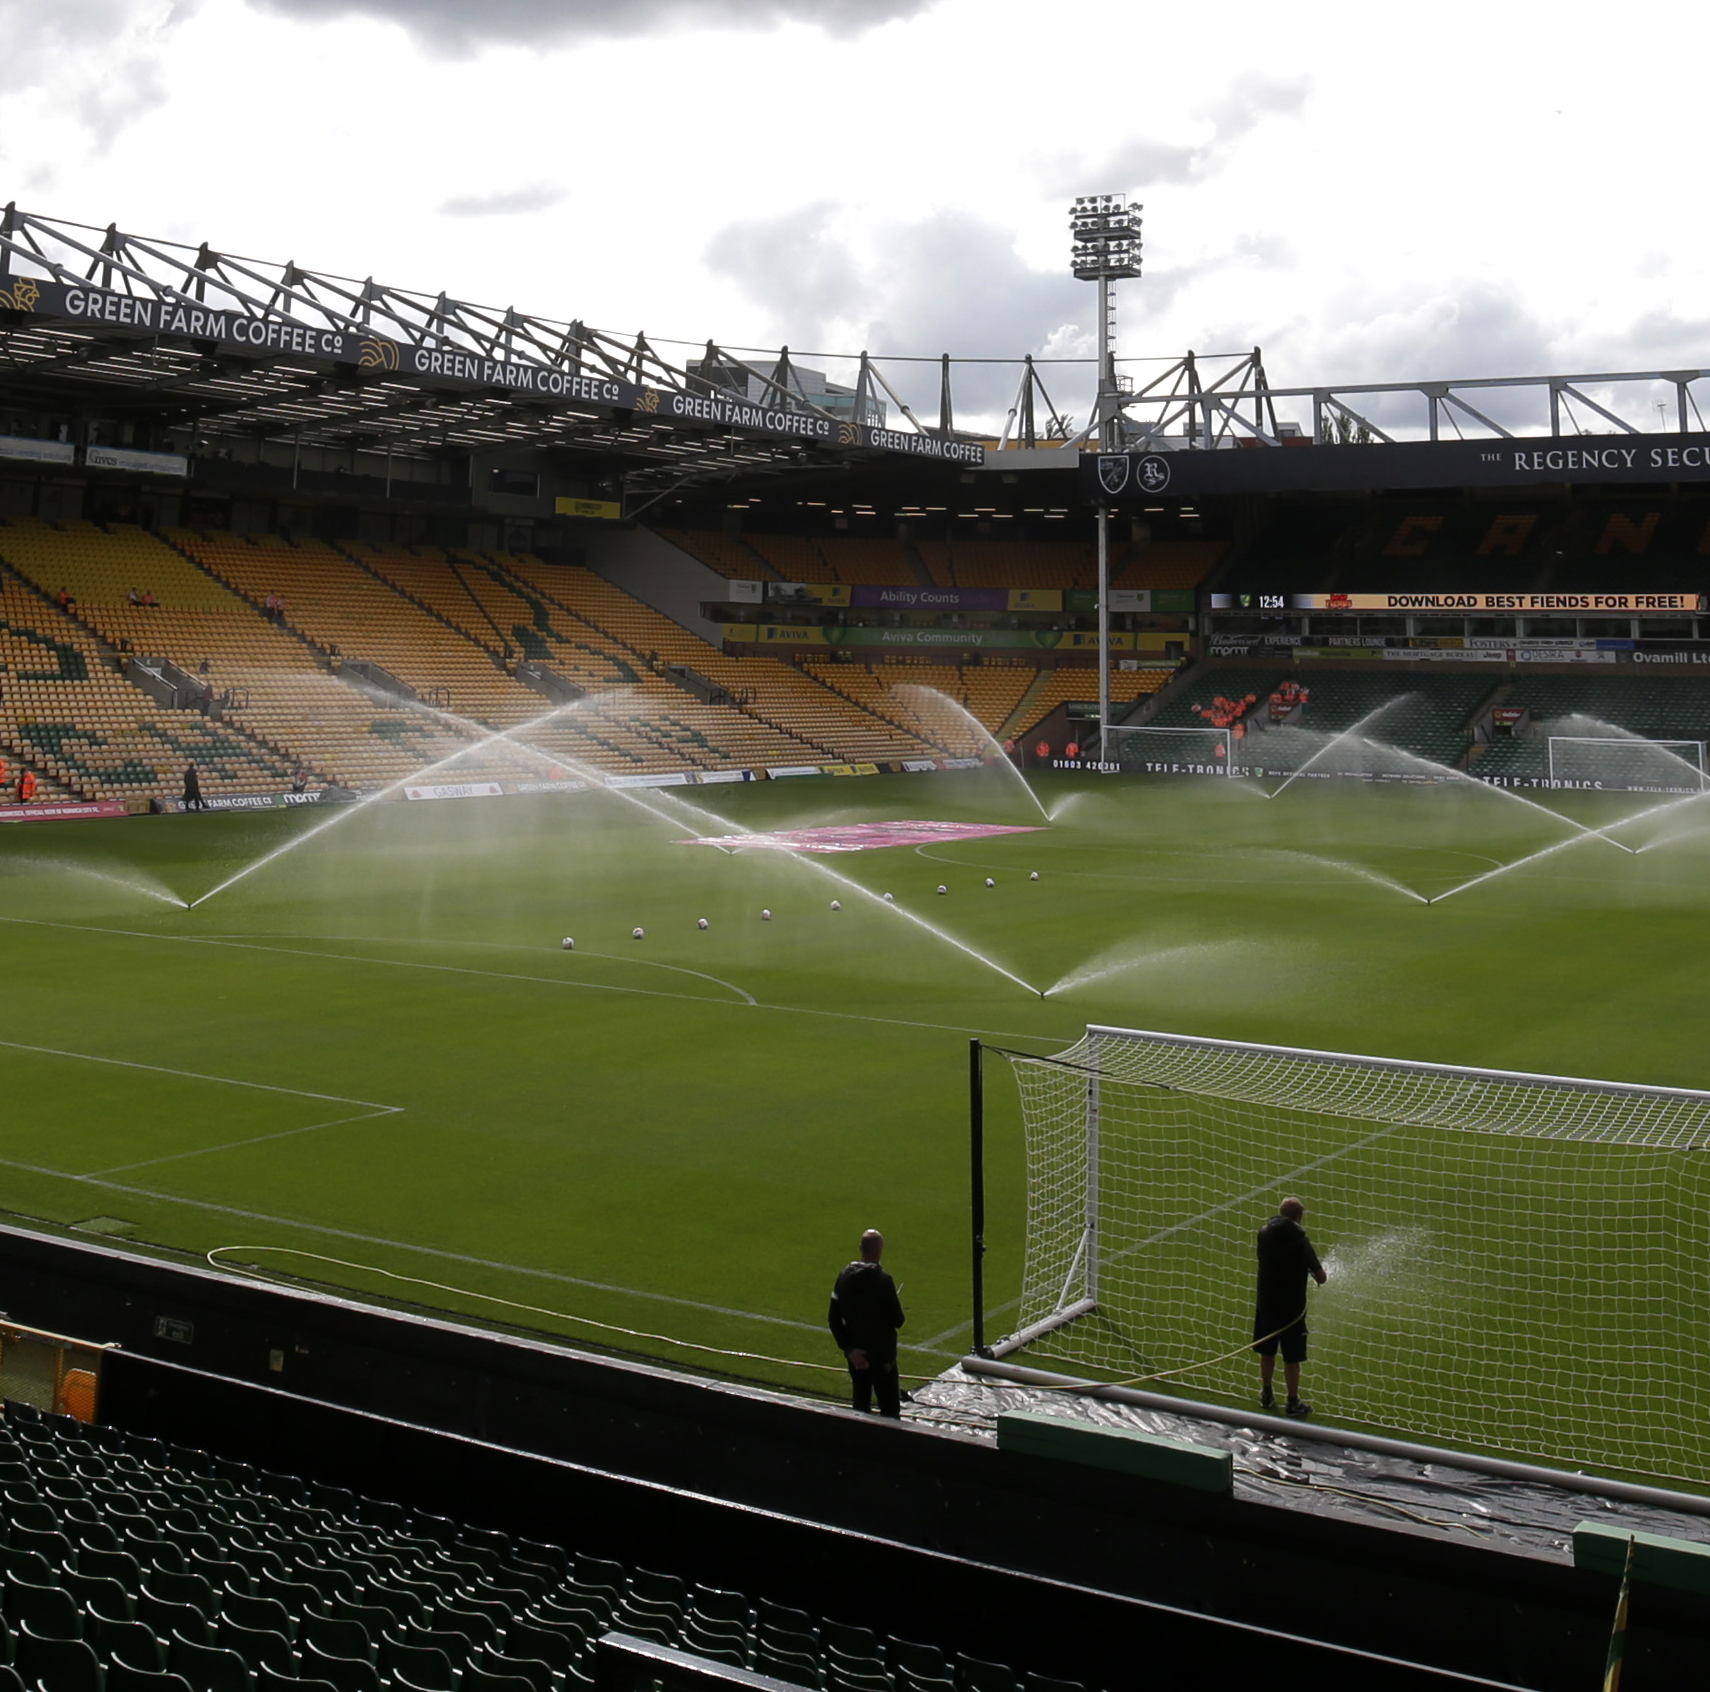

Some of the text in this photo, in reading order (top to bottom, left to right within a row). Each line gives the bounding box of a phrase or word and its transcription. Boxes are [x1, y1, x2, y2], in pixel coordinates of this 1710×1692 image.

[65, 289, 153, 327] GREEN
[158, 304, 227, 339] FARM
[232, 318, 317, 354] COFFEE
[415, 349, 488, 381] GREEN
[483, 361, 534, 390] FARM
[537, 371, 600, 401] COFFEE
[673, 395, 722, 422] GREEN
[724, 403, 763, 429] FARM
[765, 411, 815, 437] COFFEE
[870, 429, 984, 464] GREEN FARM COFFEE
[94, 454, 117, 466] nvcs
[1480, 452, 1502, 462] THE
[1513, 448, 1638, 471] REGENCY
[880, 591, 960, 605] Ability Counts
[1258, 595, 1285, 609] 12:54
[1387, 595, 1685, 608] DOWNLOAD BEST FIENDS FOR FREE!
[779, 630, 810, 639] AVIVA
[881, 631, 914, 642] Aviva
[916, 632, 983, 645] Community
[1328, 637, 1386, 647] PARTNERS LOUNGE
[1632, 652, 1688, 663] Ovamill
[433, 785, 474, 797] GASWAY
[208, 798, 232, 808] FARM
[232, 796, 262, 808] COFFEE
